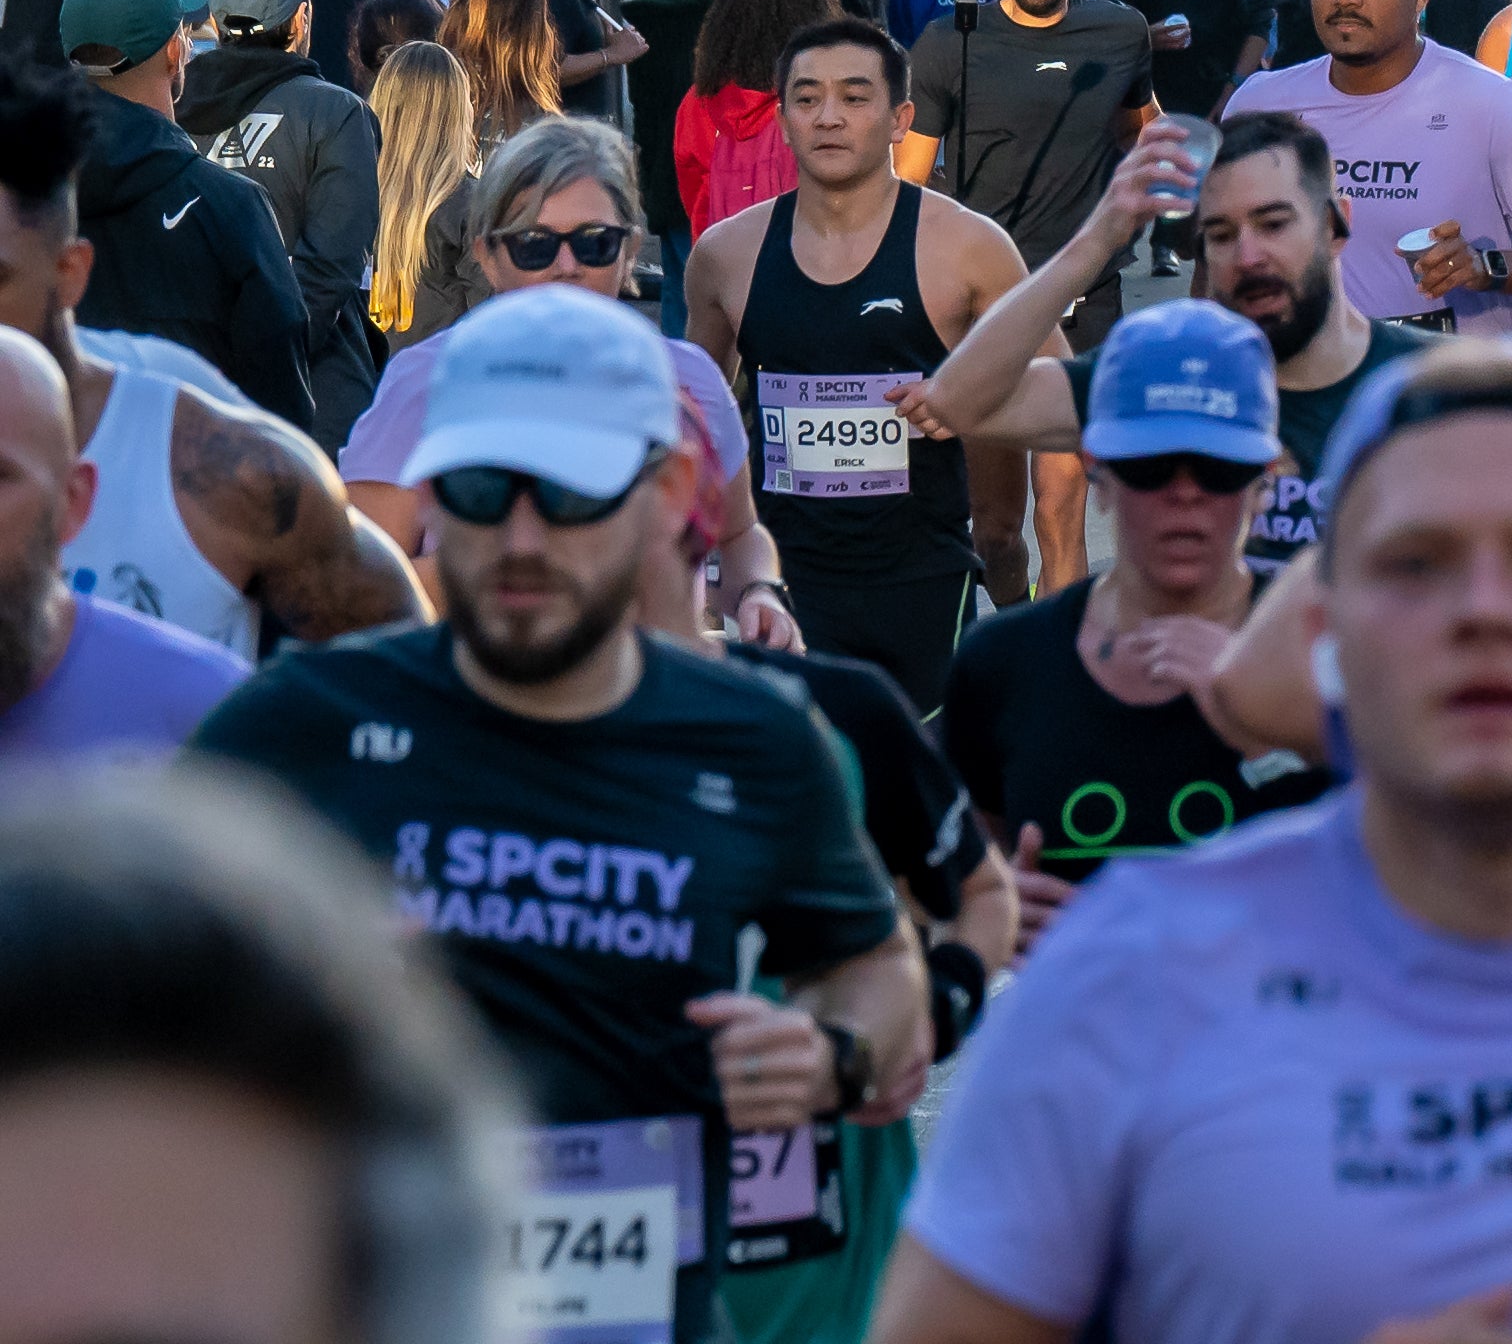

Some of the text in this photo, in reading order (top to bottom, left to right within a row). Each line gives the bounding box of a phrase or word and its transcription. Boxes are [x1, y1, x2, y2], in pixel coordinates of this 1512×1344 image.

[258, 155, 275, 169] 22
[1334, 159, 1422, 184] PCITY
[815, 380, 867, 393] SPCITY
[815, 394, 868, 403] MARATHON
[766, 413, 780, 438] D
[797, 418, 903, 448] 24930
[834, 457, 865, 468] ERICK
[441, 824, 697, 912] SPCITY
[396, 884, 695, 964] MARATHON
